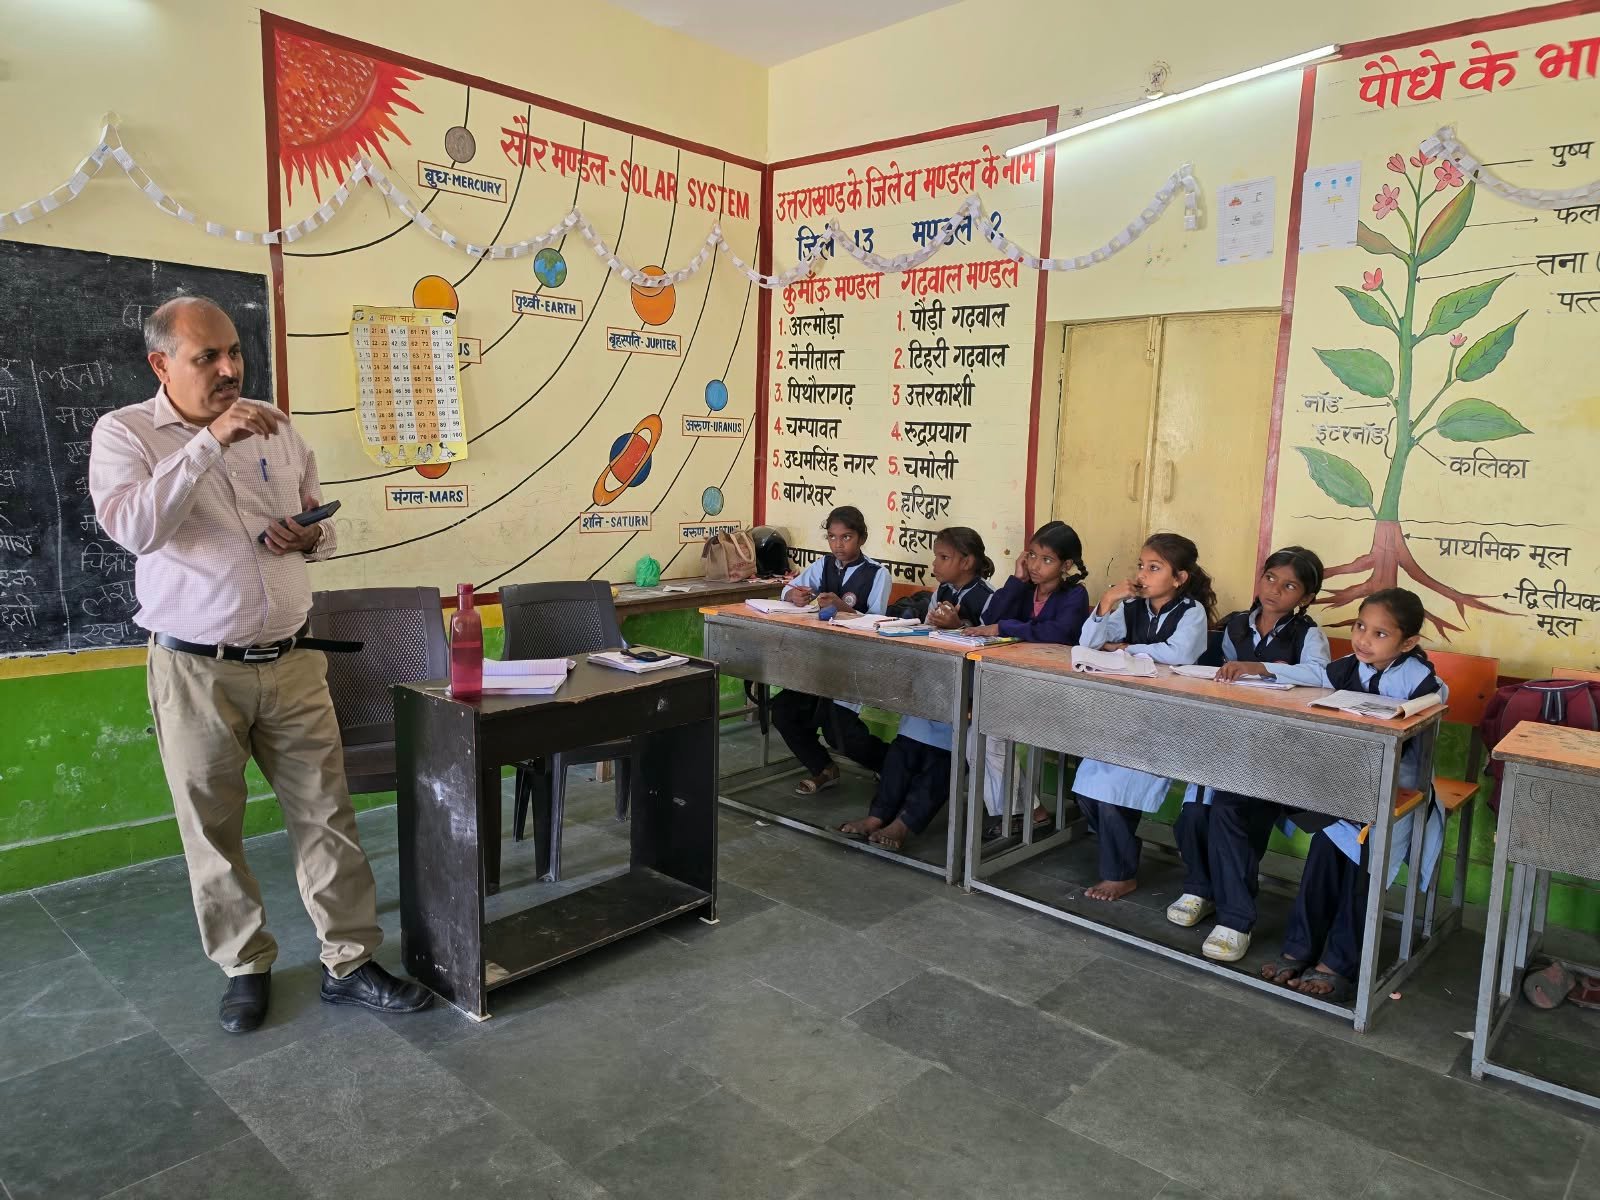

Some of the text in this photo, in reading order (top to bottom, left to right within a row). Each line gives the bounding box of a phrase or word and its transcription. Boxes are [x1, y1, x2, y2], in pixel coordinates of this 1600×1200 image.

[1459, 40, 1519, 92] के
[1535, 36, 1600, 80] भा
[500, 115, 549, 173] सौर
[620, 160, 678, 203] SOLAR
[687, 178, 749, 220] SYSTEM
[1549, 141, 1595, 167] पुष्प
[865, 160, 904, 209] जिले
[904, 169, 923, 202] व
[923, 159, 982, 199] मण्डल
[981, 144, 1001, 190] के
[1002, 151, 1041, 185] नाम
[854, 227, 875, 254] 13
[966, 257, 1024, 291] मण्डल
[1536, 252, 1589, 276] तना
[834, 272, 885, 302] मण्डल
[789, 307, 845, 340] अल्मोड़ा
[910, 298, 947, 336] पौड़ी
[951, 303, 1010, 333] गढ़वाल
[788, 342, 845, 370] नैनीताल
[908, 337, 950, 375] टिहरी
[953, 344, 1010, 373] गढ़वाल
[787, 375, 856, 410] पिथौरागढ़
[905, 374, 976, 408] उत्तरकाशी
[785, 416, 843, 439] चम्पावत
[843, 453, 878, 475] नगर
[903, 450, 959, 480] चमोली
[1449, 447, 1531, 479] कलिका
[783, 475, 836, 506] बागेश्वर
[901, 485, 951, 520] हरिद्वार
[899, 520, 938, 553] देहरा
[1434, 532, 1572, 570] प्राथमिक मूल
[1514, 577, 1600, 612] द्वितीयक
[1537, 614, 1583, 638] मूल
